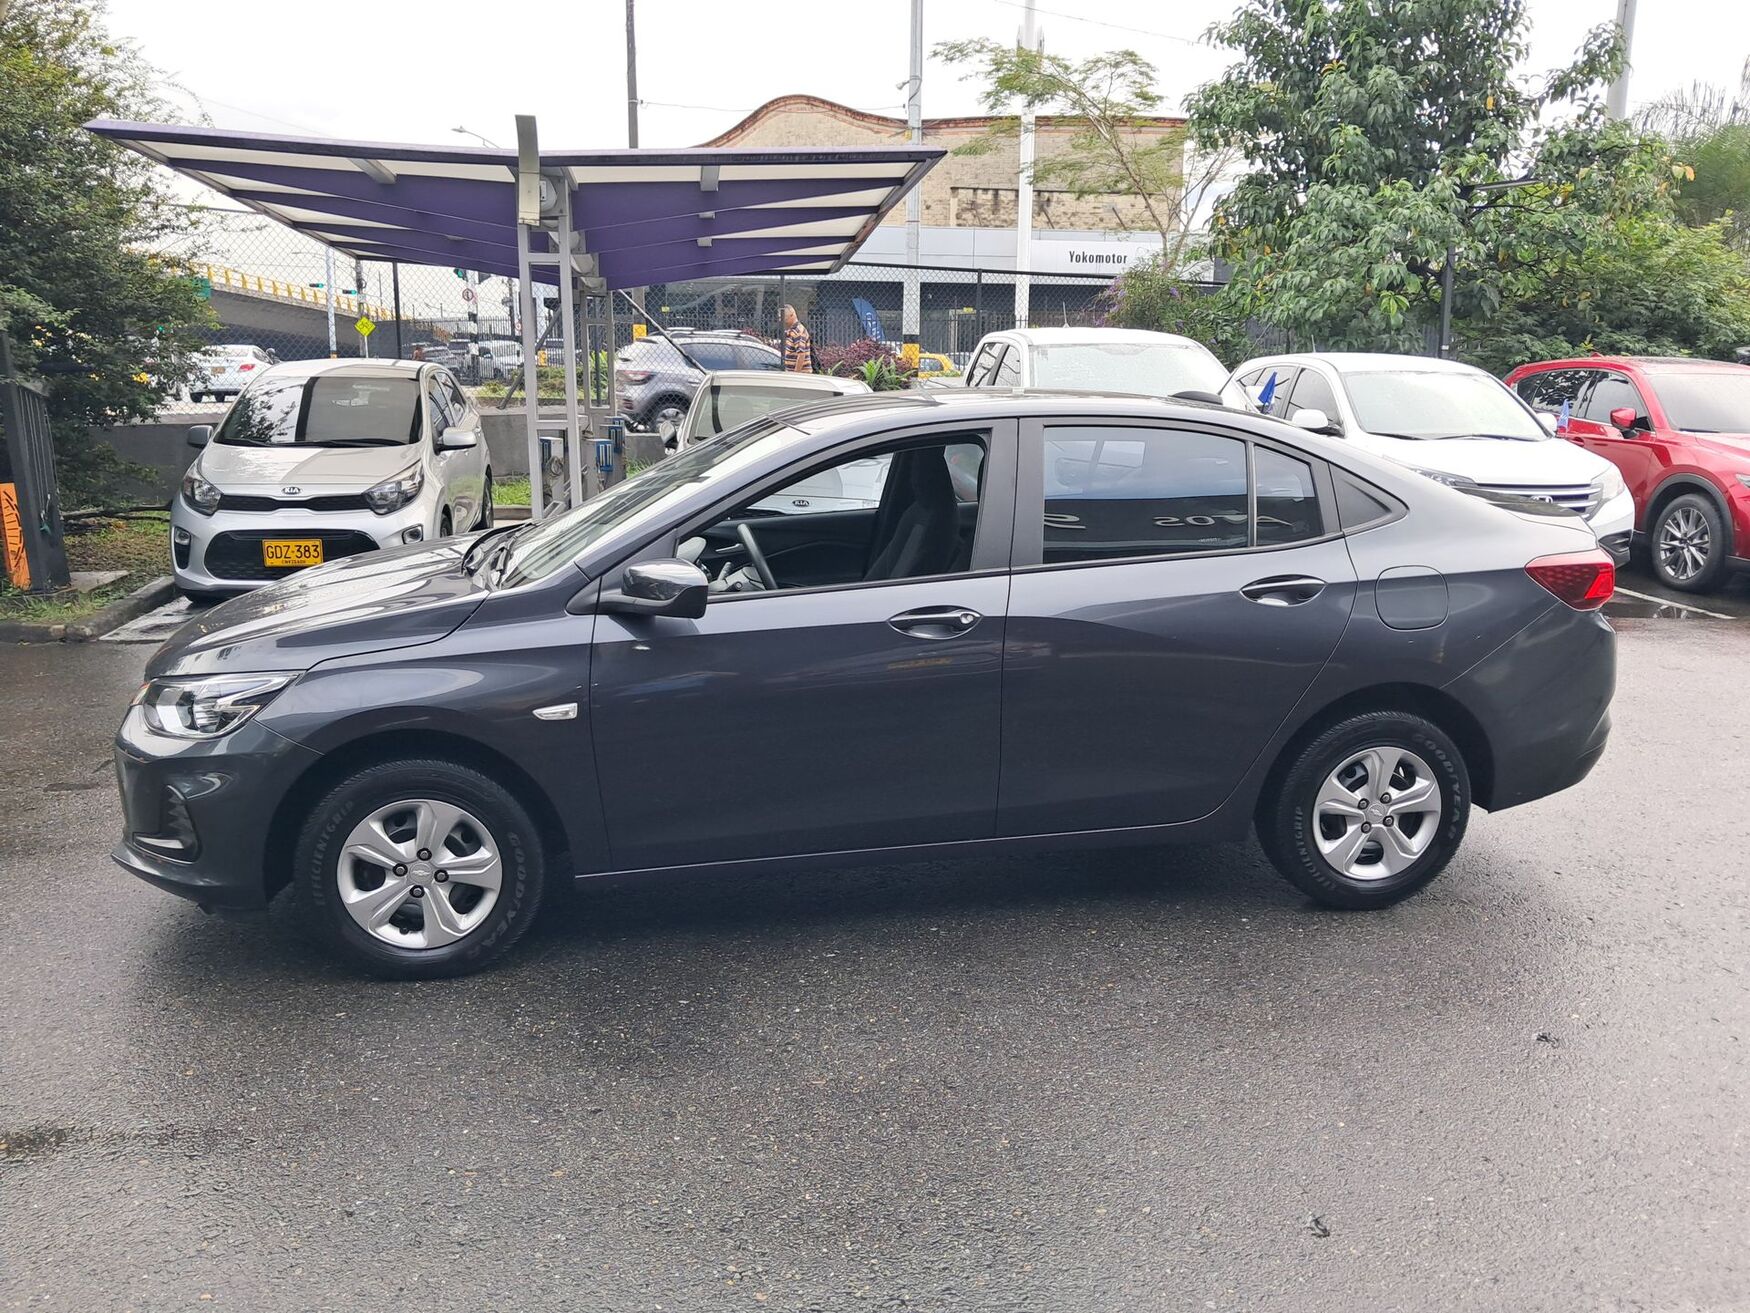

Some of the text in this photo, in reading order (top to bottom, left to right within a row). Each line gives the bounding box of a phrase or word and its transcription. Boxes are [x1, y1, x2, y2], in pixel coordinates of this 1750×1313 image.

[1069, 251, 1127, 264] Yokomotor
[1412, 733, 1461, 839] GOODYEAR
[467, 831, 527, 957] GOODYEAR
